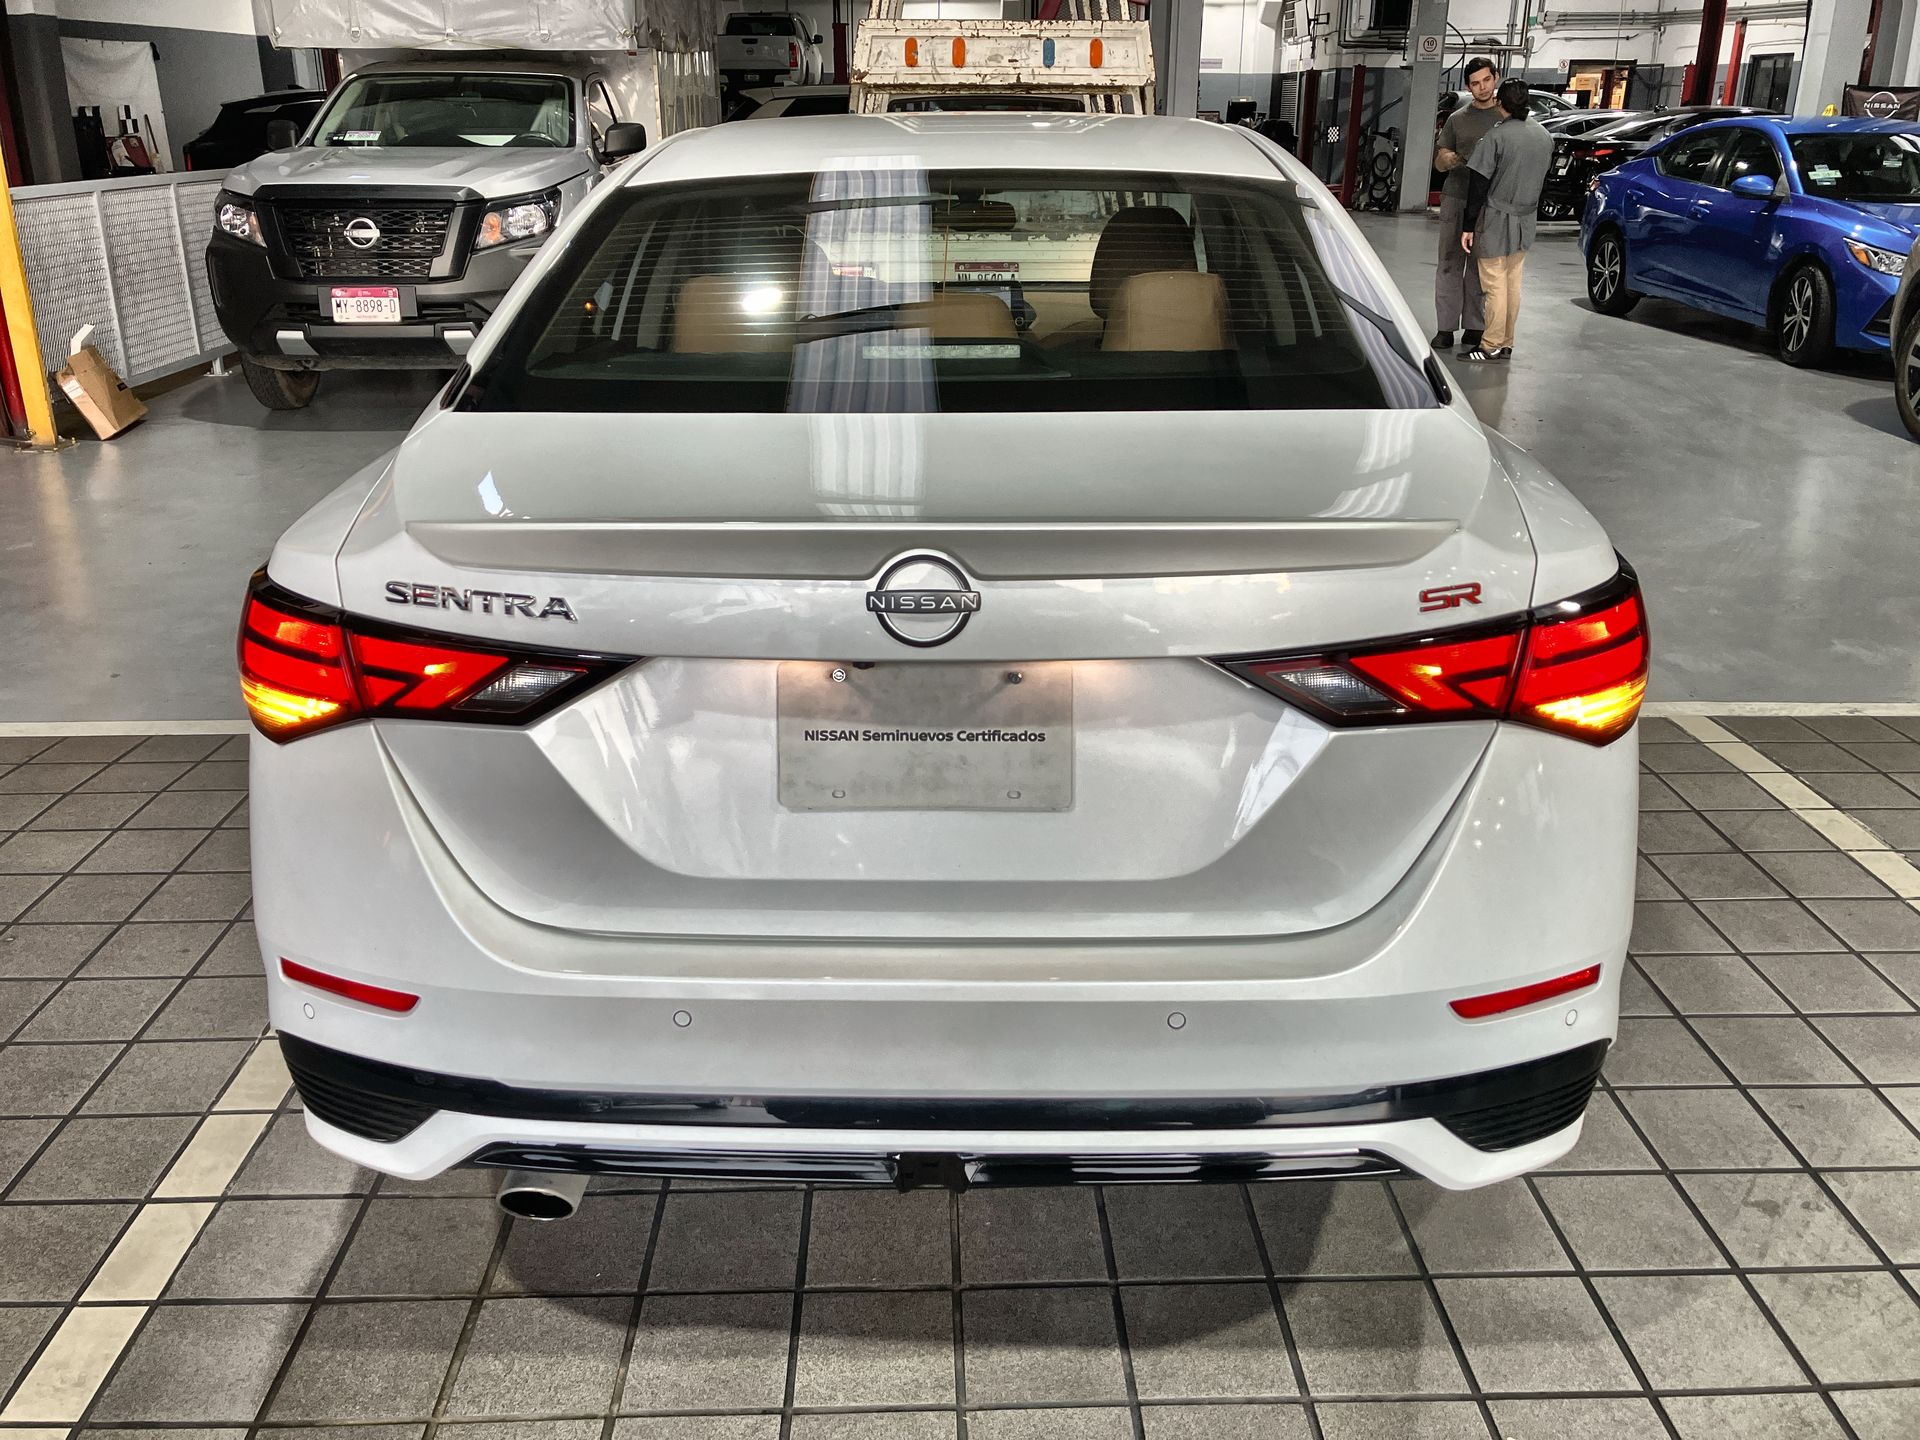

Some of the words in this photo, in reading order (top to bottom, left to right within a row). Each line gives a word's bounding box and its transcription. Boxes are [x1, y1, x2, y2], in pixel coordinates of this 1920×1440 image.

[385, 580, 579, 624] SENTRA
[869, 595, 978, 609] NISSAN
[1419, 582, 1483, 613] SR
[804, 729, 859, 741] NISSAN
[862, 729, 954, 742] Seminuevos
[956, 729, 1046, 742] Certificados
